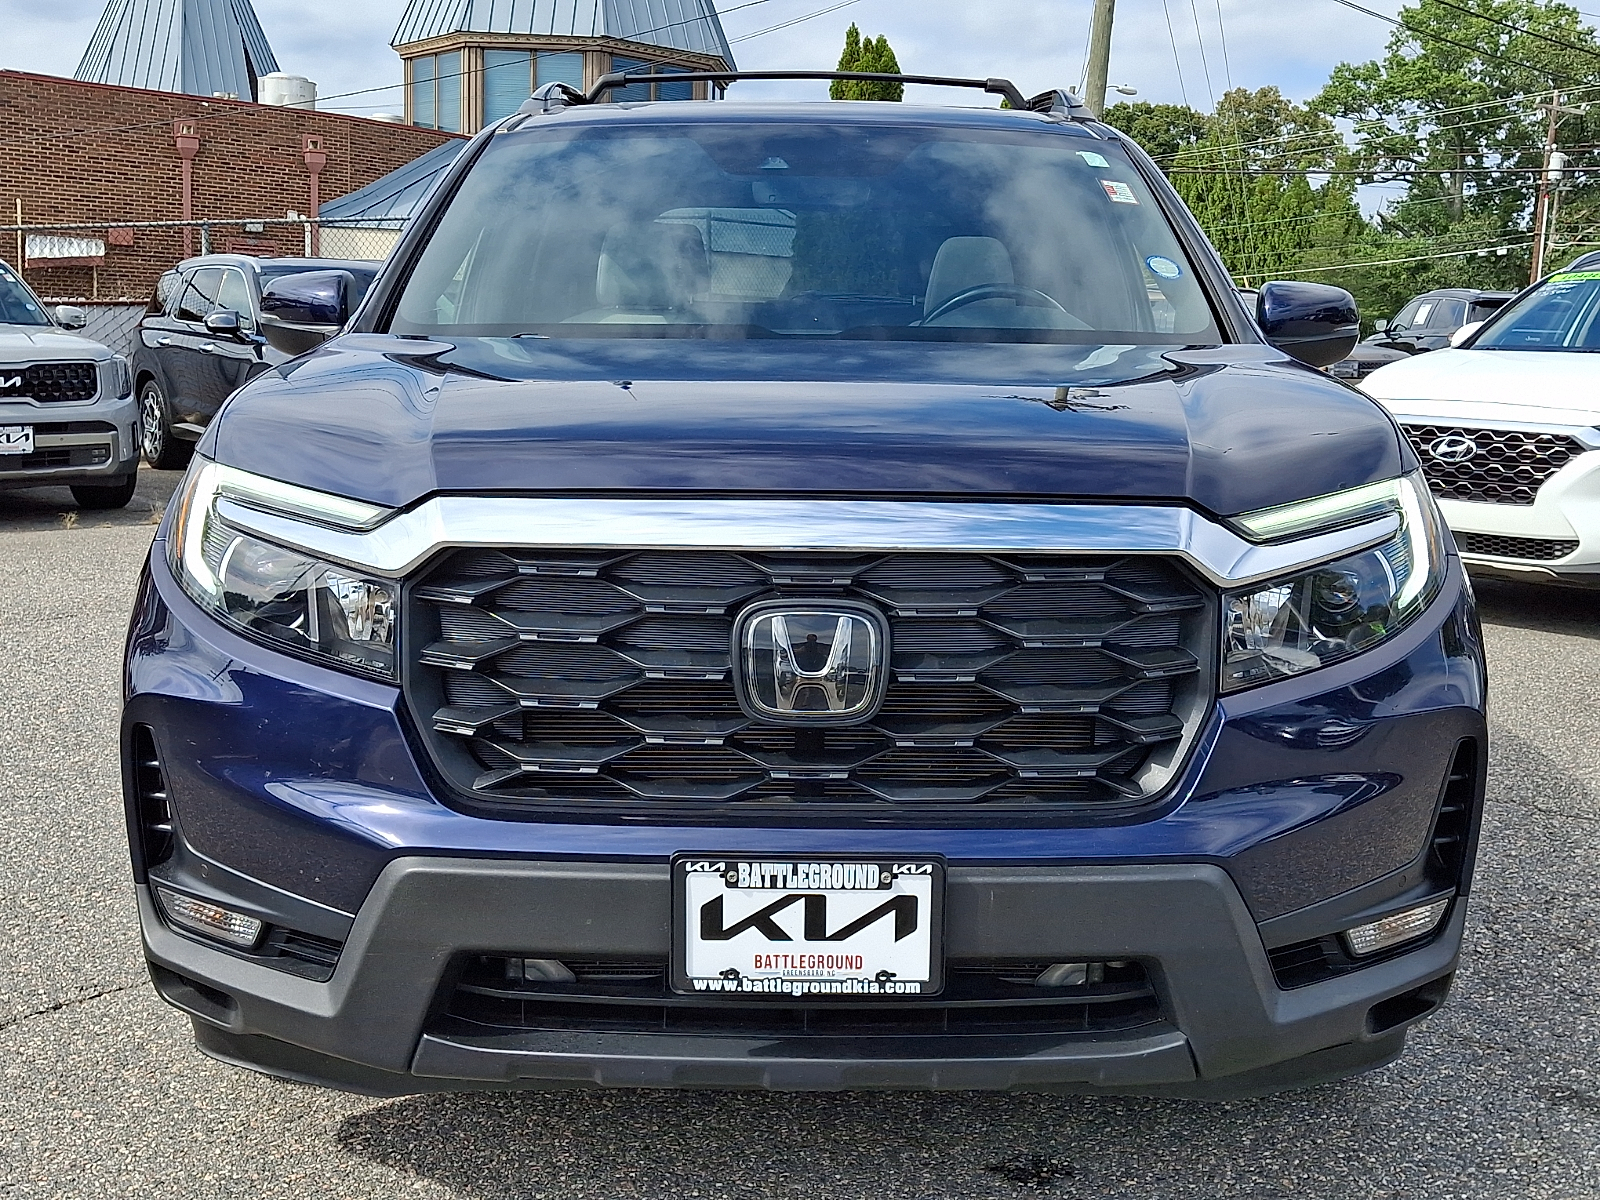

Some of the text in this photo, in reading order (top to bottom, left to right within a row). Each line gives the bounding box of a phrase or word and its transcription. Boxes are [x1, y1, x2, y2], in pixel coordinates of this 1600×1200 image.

[0, 376, 21, 387] IA
[686, 861, 933, 889] KIA BATTLEGROUND KIA
[700, 893, 919, 943] KIA
[754, 954, 864, 970] BATTLEGROUND
[782, 969, 825, 977] GREENSBORO
[693, 976, 921, 996] www.battlegroundkia.com
